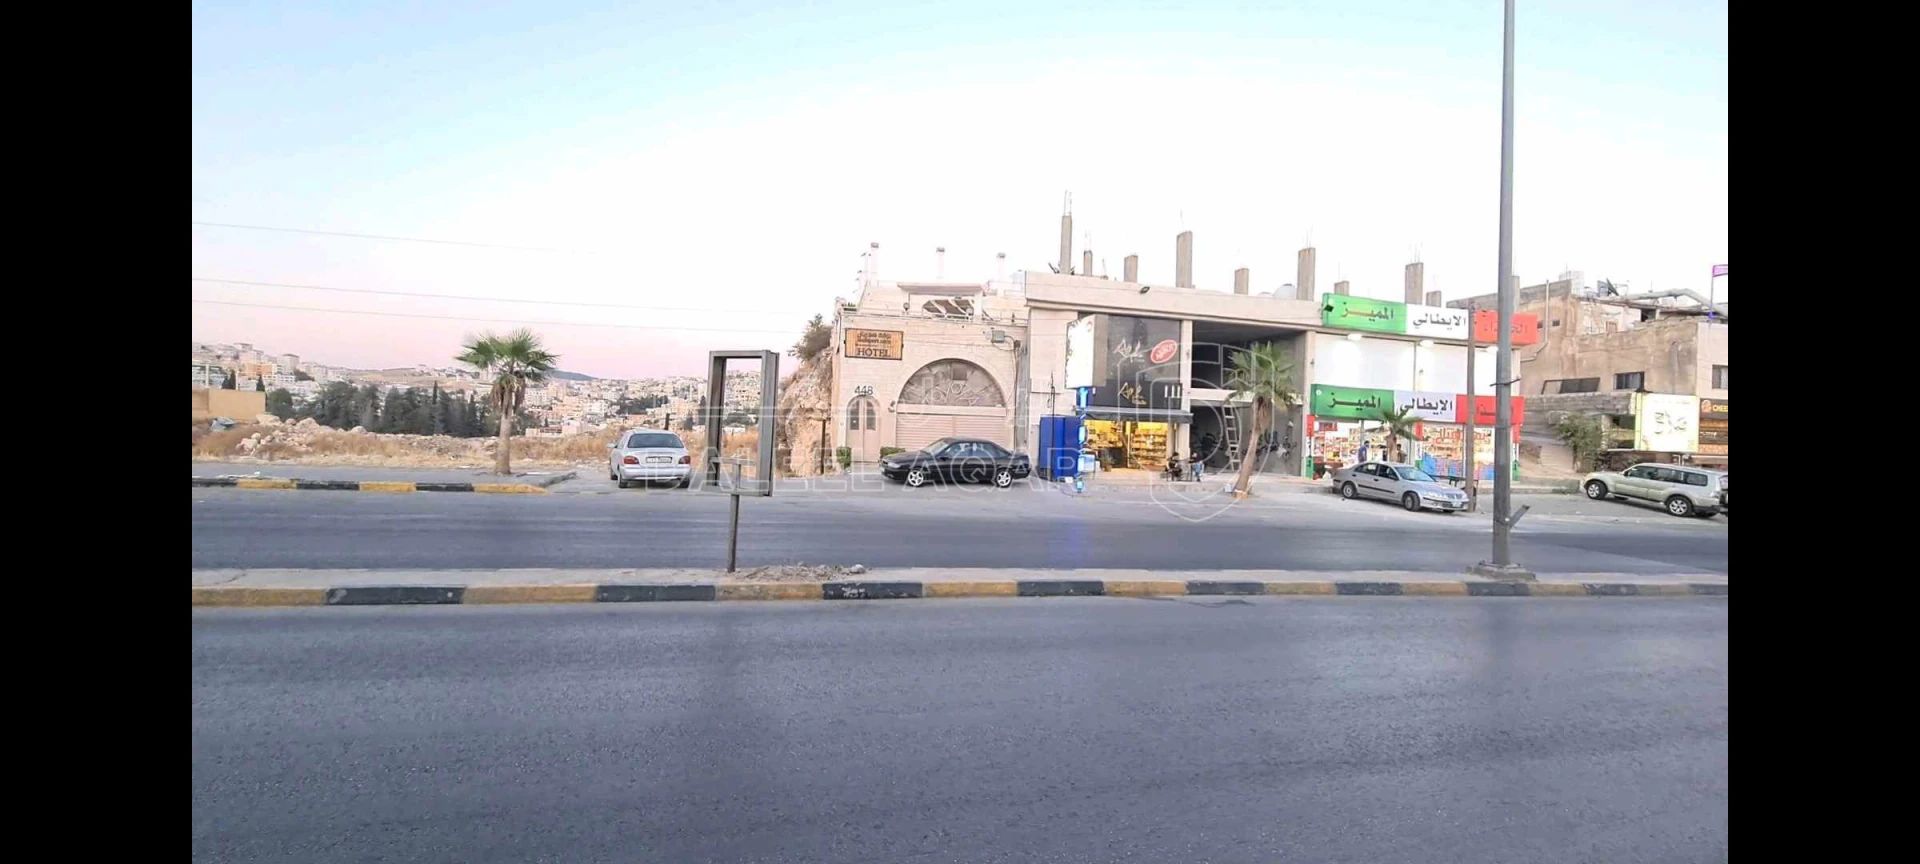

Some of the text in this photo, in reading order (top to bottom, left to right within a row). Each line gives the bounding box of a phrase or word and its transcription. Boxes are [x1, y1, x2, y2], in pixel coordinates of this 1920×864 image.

[1341, 301, 1394, 322] المميز
[857, 347, 891, 357] HOTEL
[854, 385, 874, 396] 448
[1327, 392, 1381, 411] المميز
